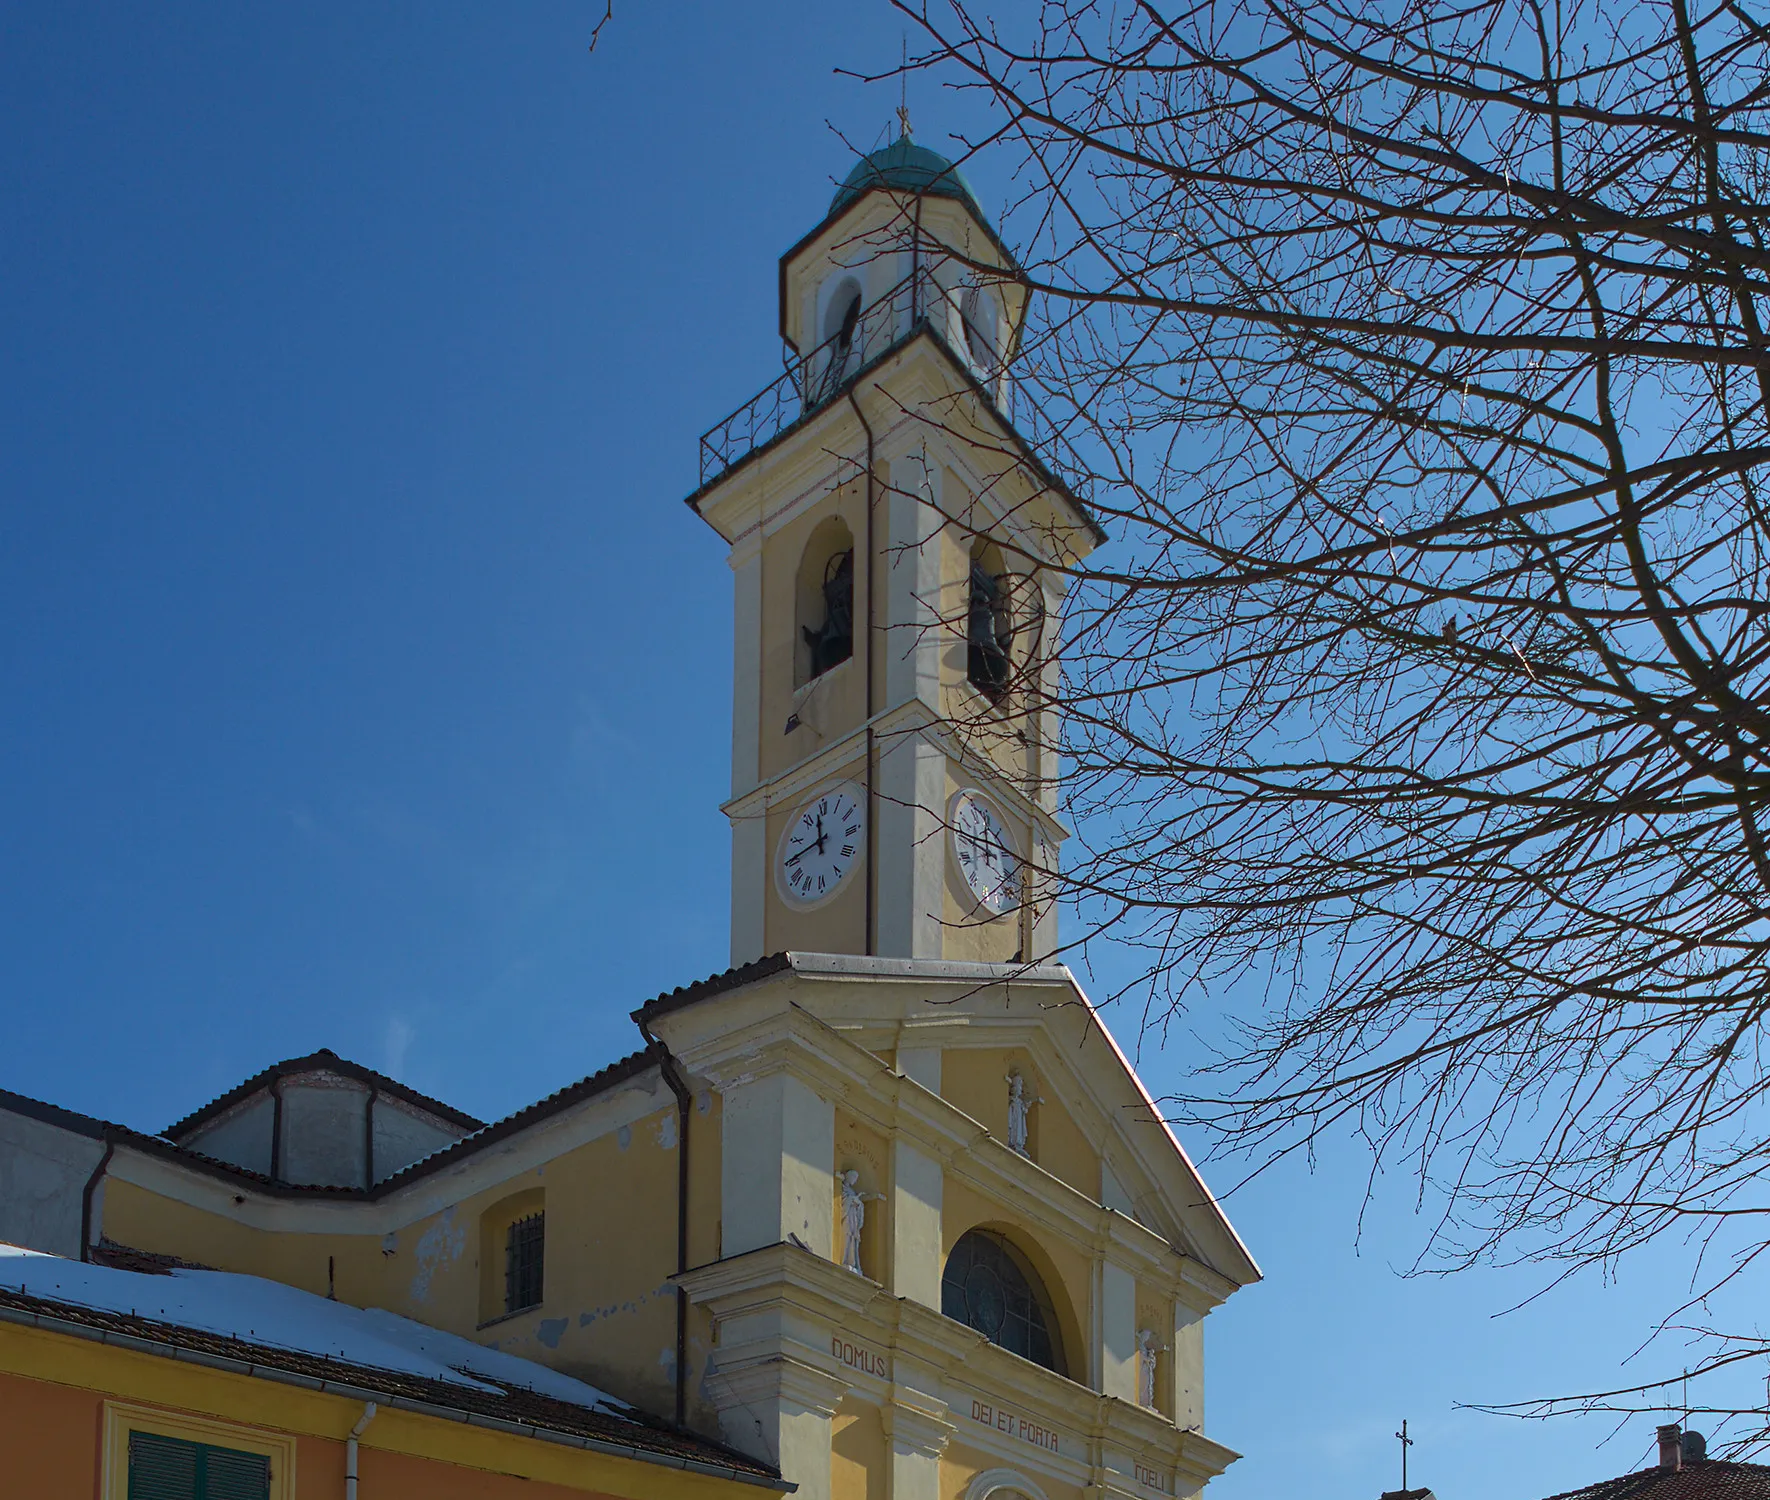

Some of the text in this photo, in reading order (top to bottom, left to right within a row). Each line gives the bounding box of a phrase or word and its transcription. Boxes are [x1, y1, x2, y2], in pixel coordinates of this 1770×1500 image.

[832, 1336, 886, 1378] DOMUS
[971, 1399, 993, 1426] DEI
[997, 1410, 1015, 1434] ET
[1019, 1419, 1059, 1452] PORTA
